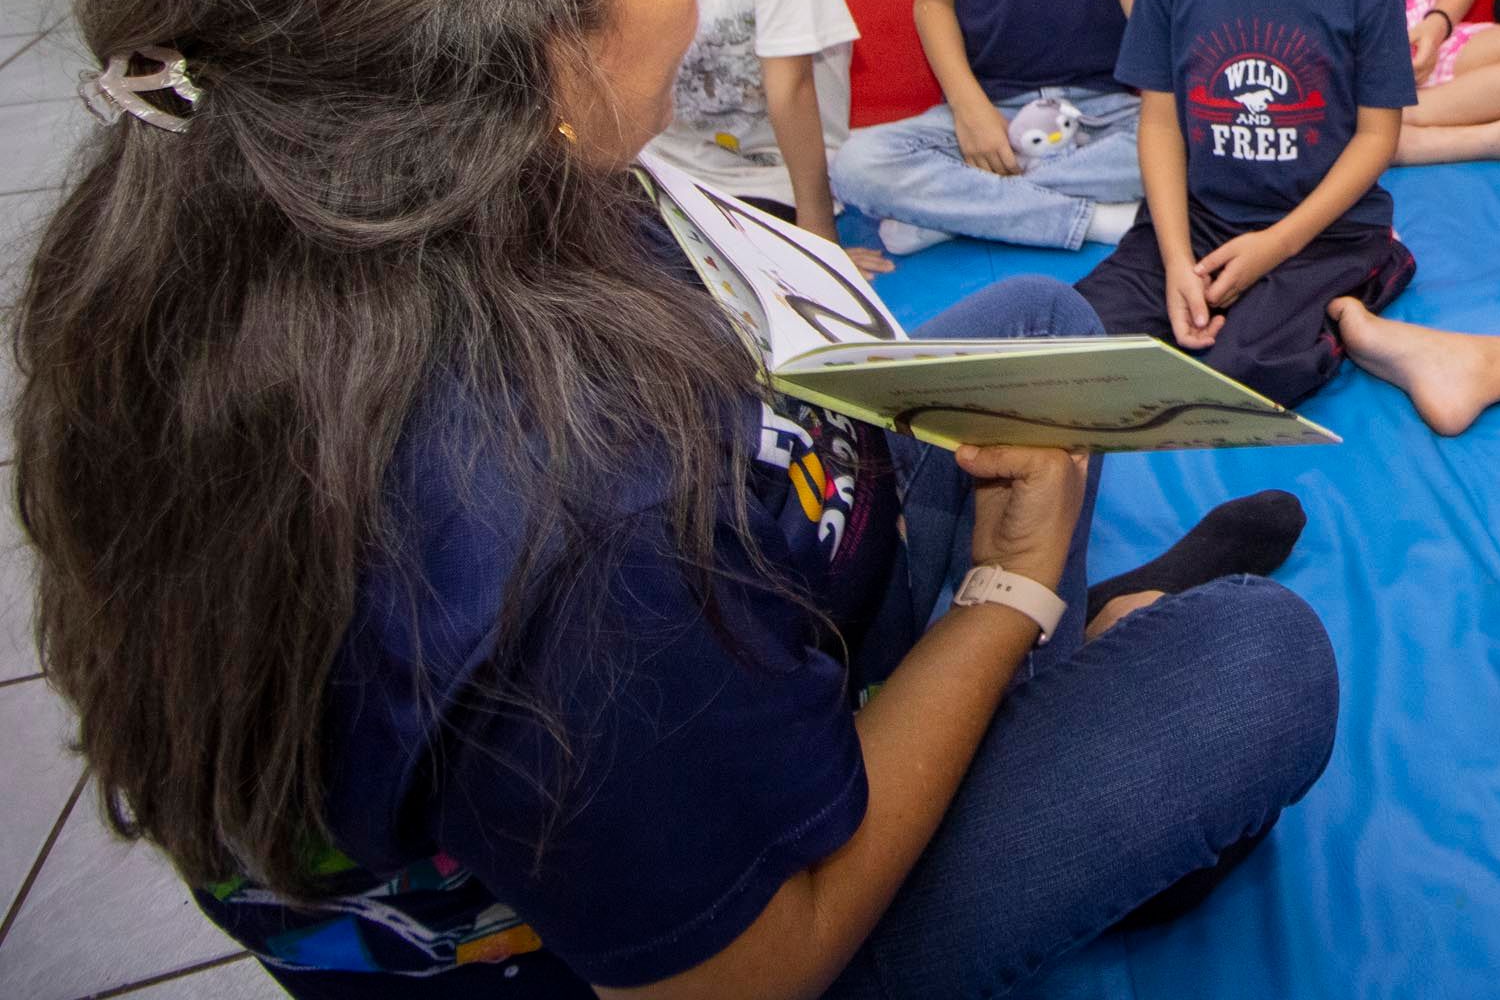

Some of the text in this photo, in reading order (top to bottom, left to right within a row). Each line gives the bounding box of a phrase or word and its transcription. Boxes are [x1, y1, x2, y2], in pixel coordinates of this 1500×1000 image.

[1224, 59, 1288, 95] WILD
[1236, 113, 1271, 126] AND
[1211, 124, 1298, 161] FREE
